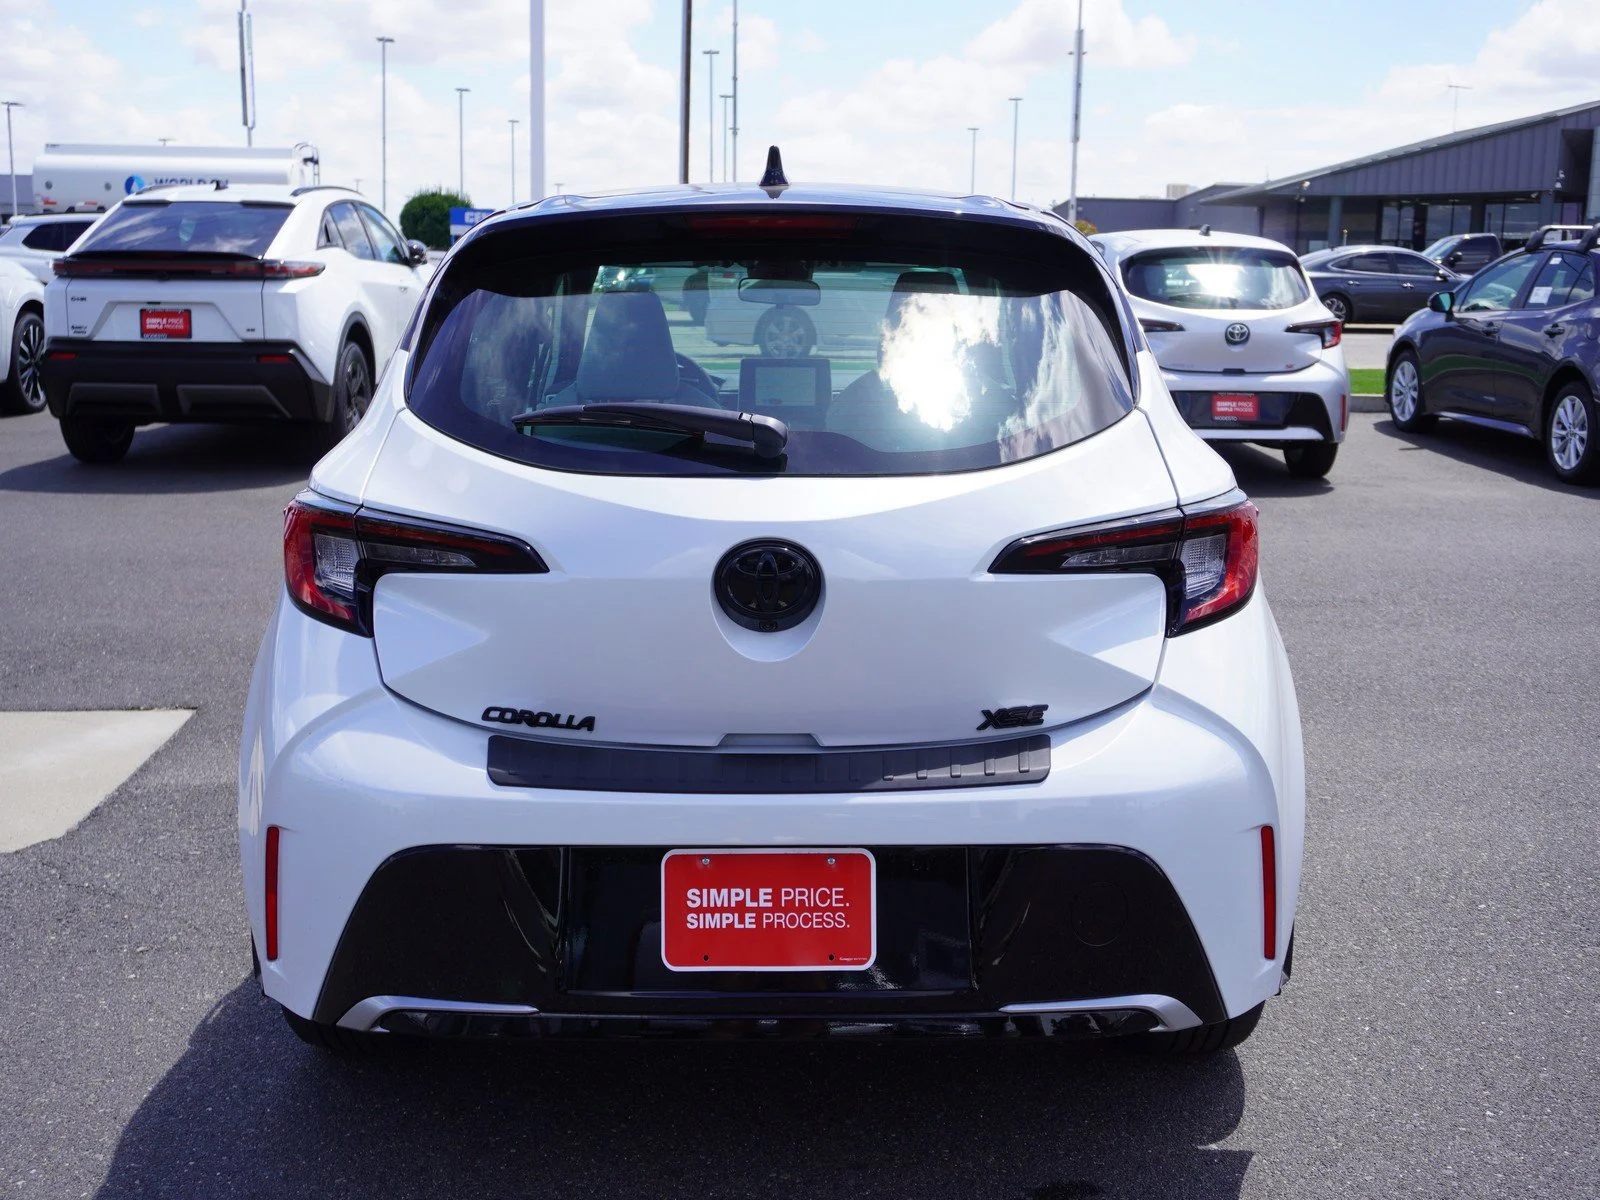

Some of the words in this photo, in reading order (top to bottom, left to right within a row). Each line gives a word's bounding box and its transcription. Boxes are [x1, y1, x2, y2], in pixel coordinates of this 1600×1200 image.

[481, 706, 596, 732] COROLLA
[976, 704, 1049, 731] XSE
[686, 887, 773, 909] SIMPLE
[781, 887, 850, 908] PRICE.
[686, 912, 757, 930] SIMPLE
[762, 911, 850, 930] PROCESS.
